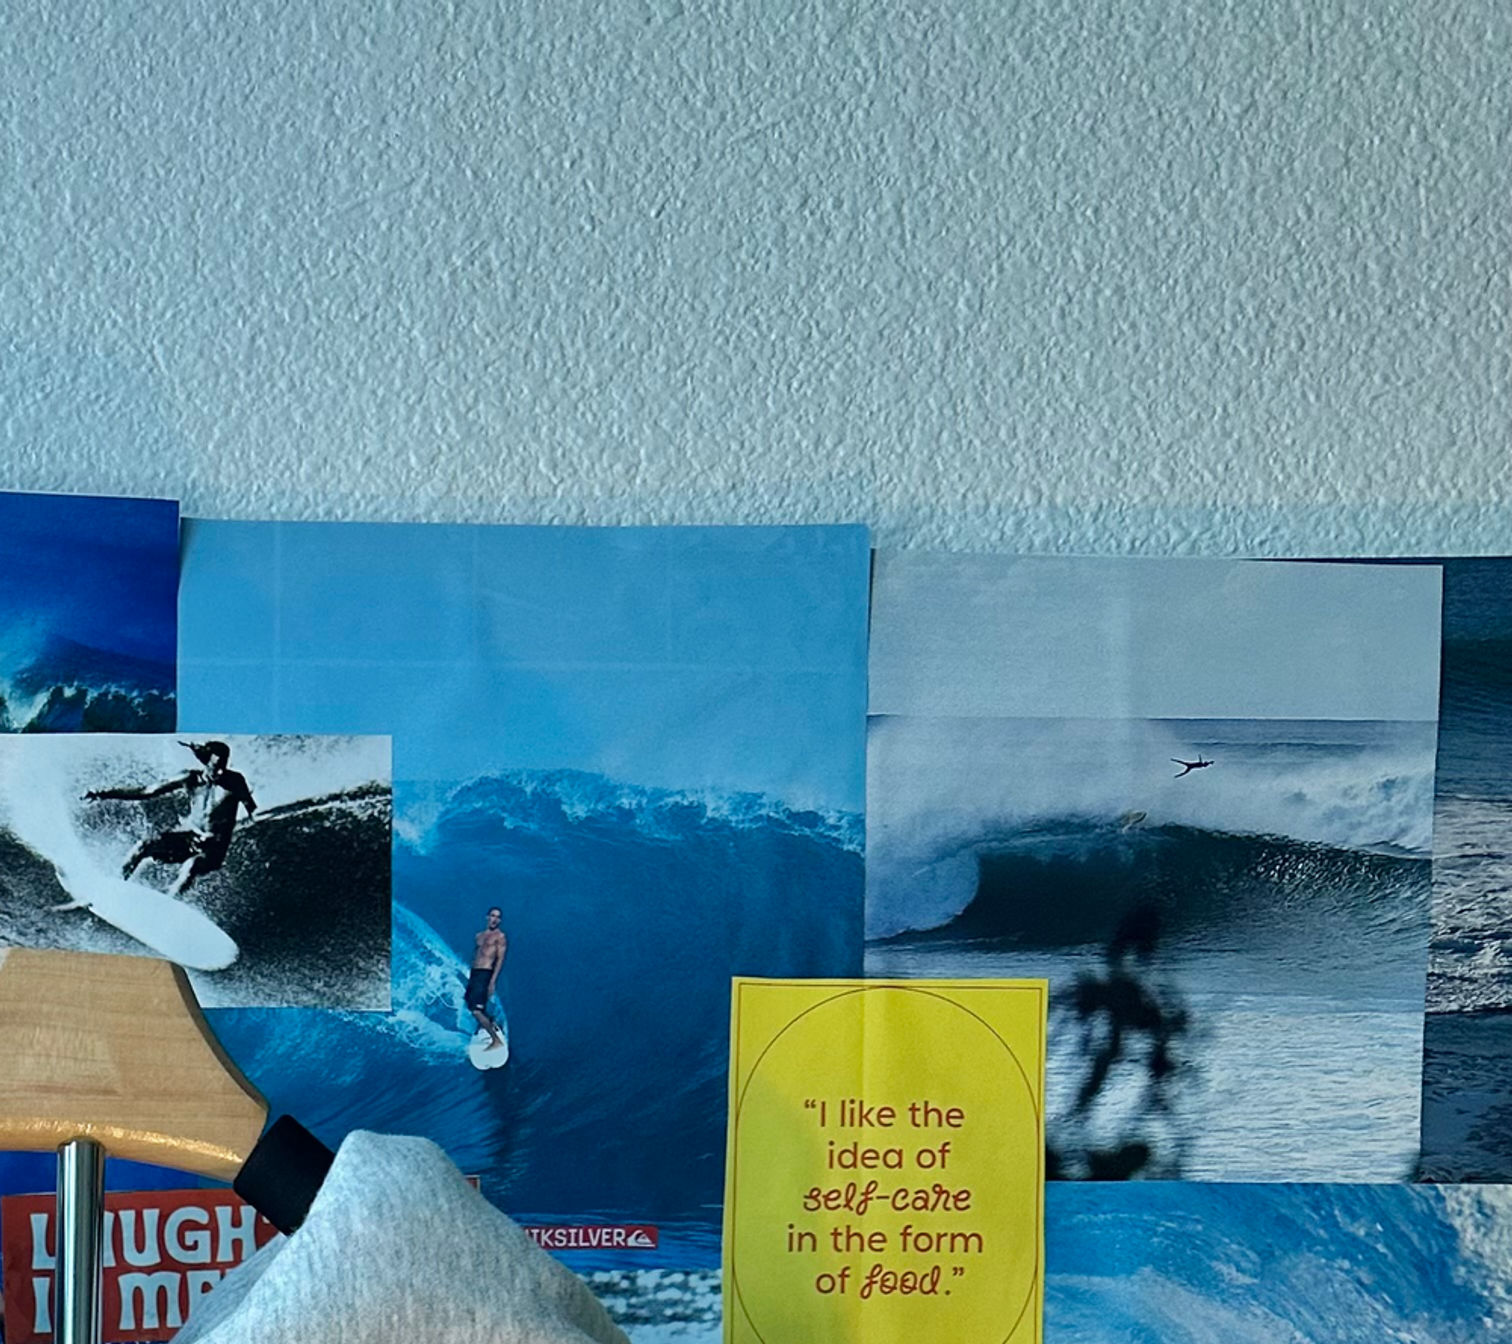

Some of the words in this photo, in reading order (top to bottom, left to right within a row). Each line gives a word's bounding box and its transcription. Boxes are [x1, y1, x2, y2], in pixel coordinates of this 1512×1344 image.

[840, 1099, 897, 1128] like
[908, 1100, 965, 1128] the
[828, 1140, 904, 1169] idea
[916, 1141, 951, 1169] of
[803, 1180, 972, 1216] self-care
[526, 1227, 625, 1247] IKSILVER
[788, 1223, 817, 1252] in
[830, 1224, 887, 1252] the
[900, 1224, 984, 1253] form
[815, 1266, 851, 1294] of
